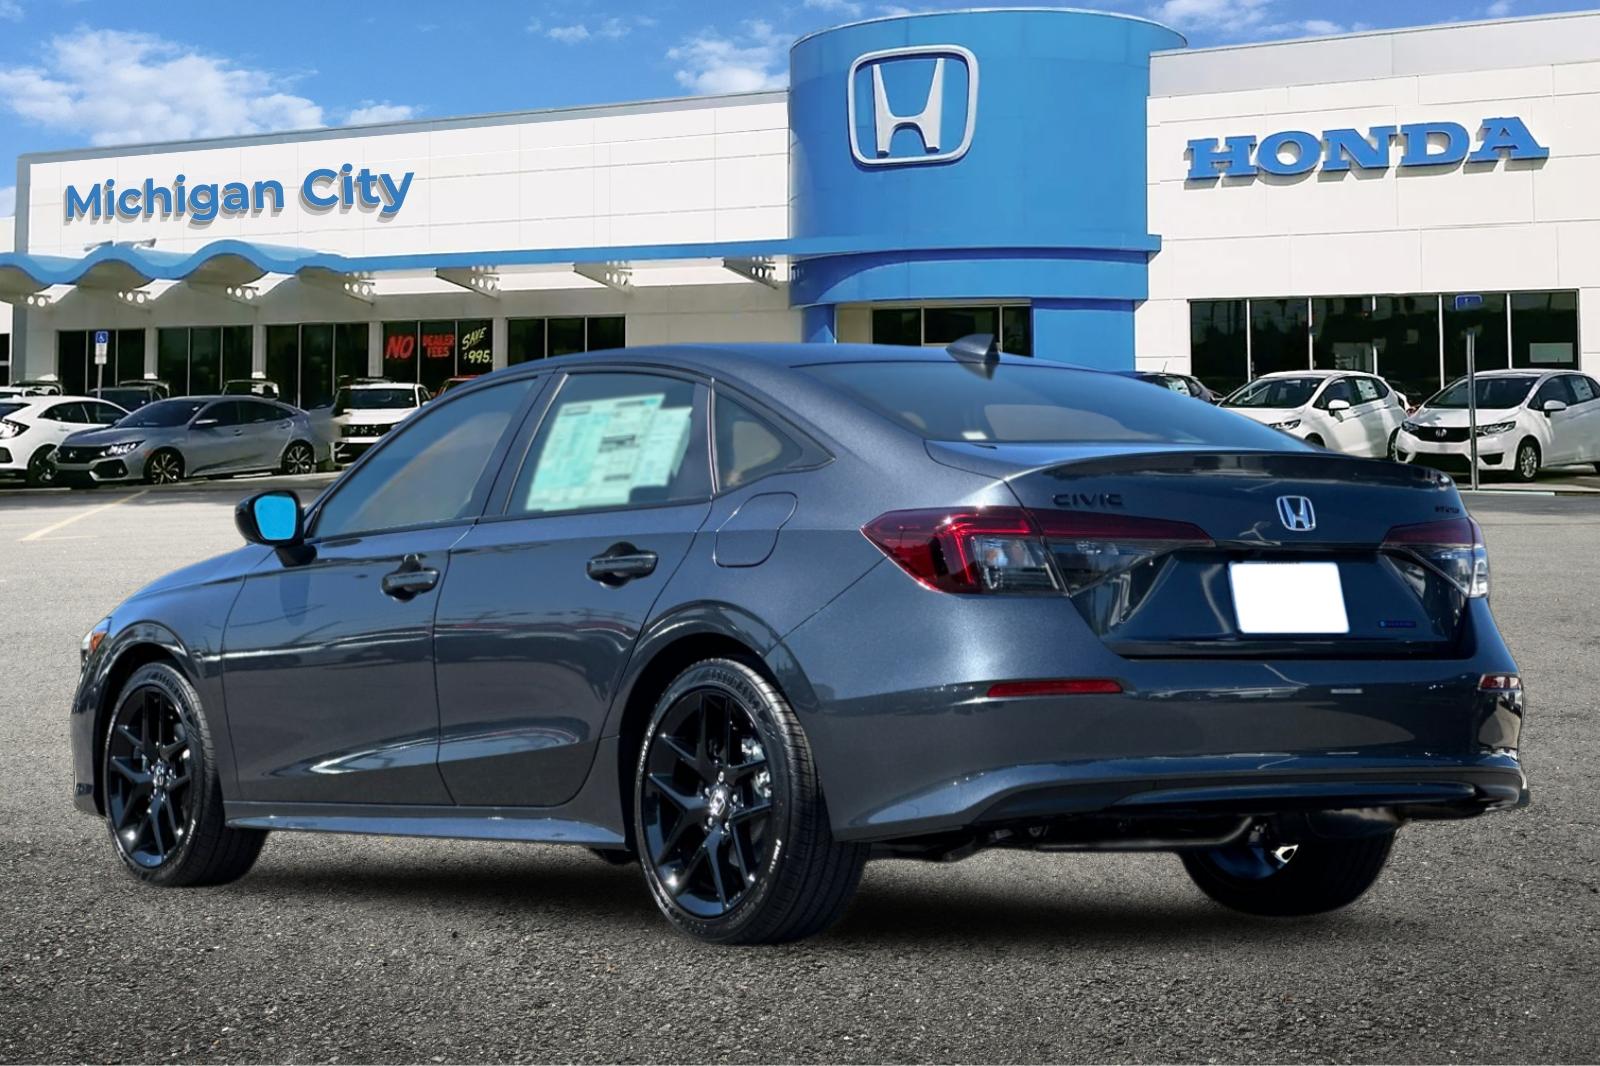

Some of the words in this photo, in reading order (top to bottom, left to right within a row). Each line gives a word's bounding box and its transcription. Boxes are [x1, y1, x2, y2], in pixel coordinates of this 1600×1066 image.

[1185, 115, 1550, 183] HONDA
[64, 173, 286, 222] Michigan
[300, 163, 415, 216] City
[385, 335, 415, 359] NO
[462, 327, 487, 350] SAVE
[1052, 493, 1123, 506] CIVIC
